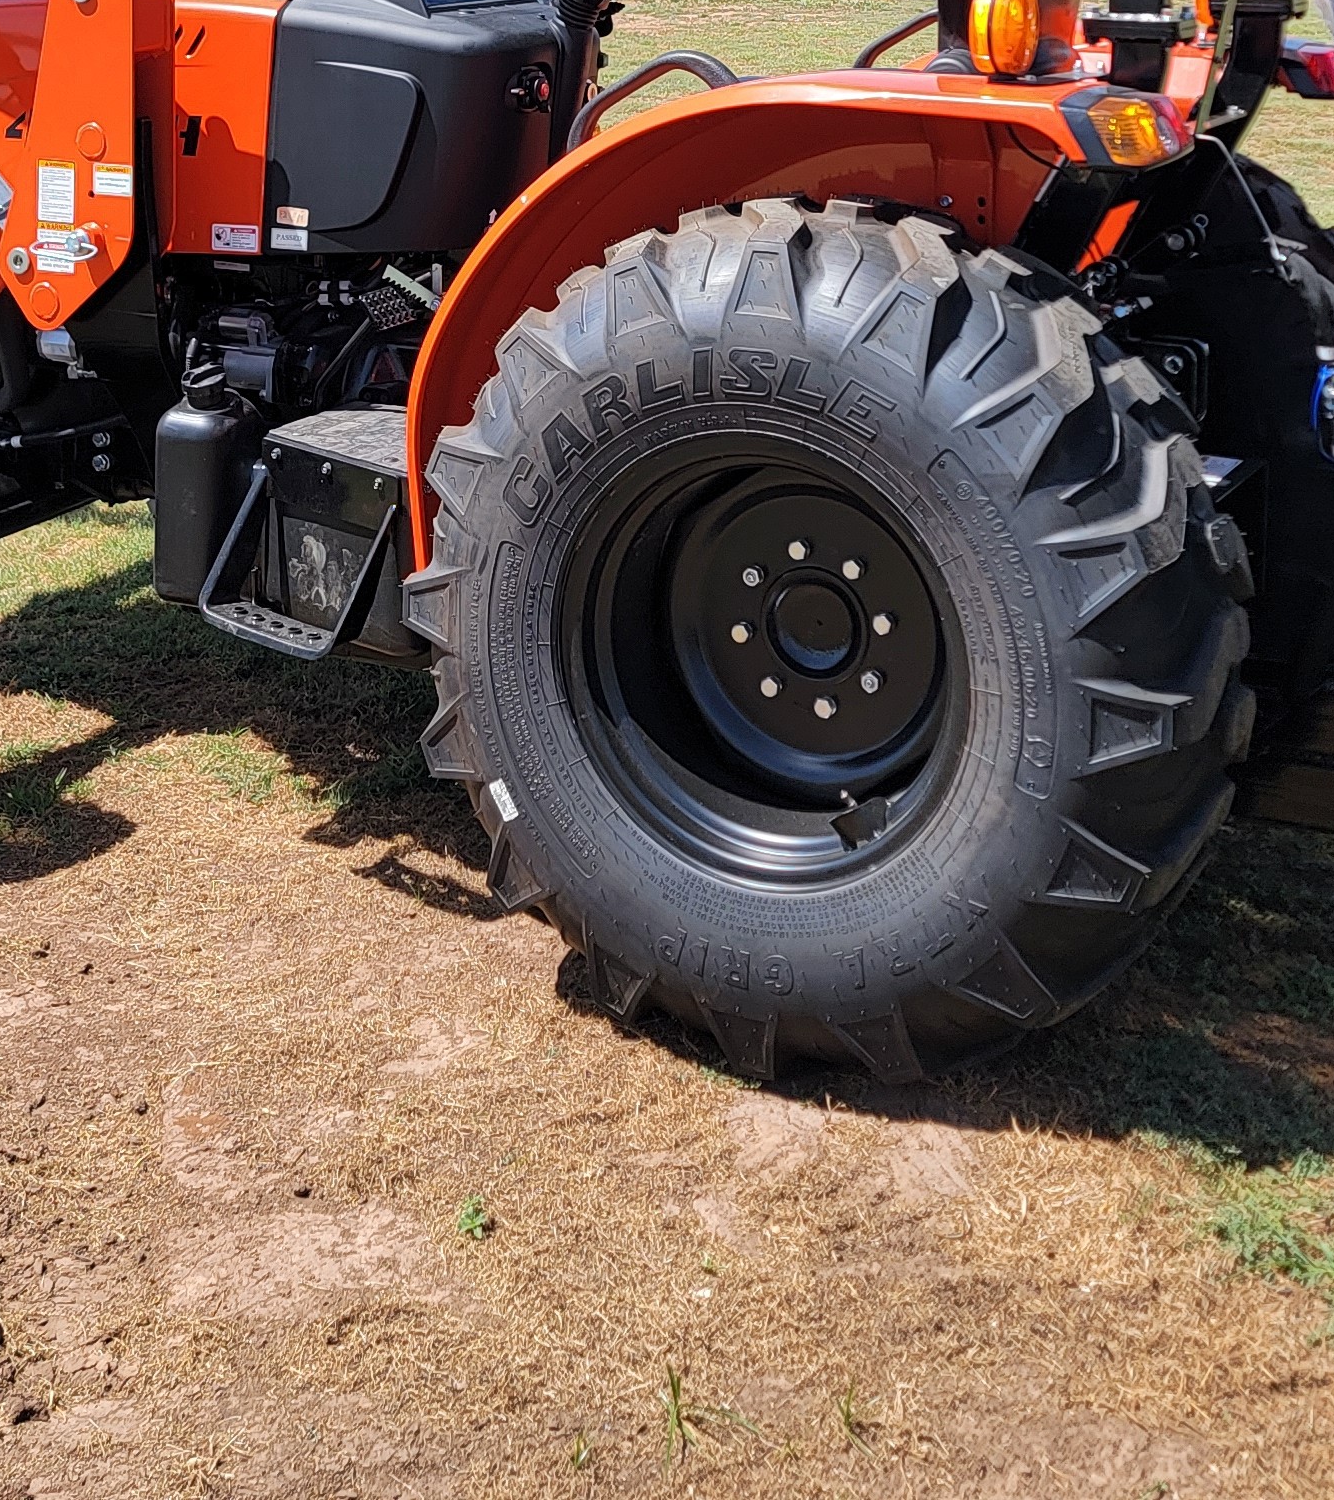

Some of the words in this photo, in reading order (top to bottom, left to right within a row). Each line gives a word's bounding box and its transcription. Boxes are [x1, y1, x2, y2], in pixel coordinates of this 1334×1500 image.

[275, 233, 303, 243] PASSED
[501, 346, 898, 528] CARLISLE
[657, 926, 795, 996] GRIP
